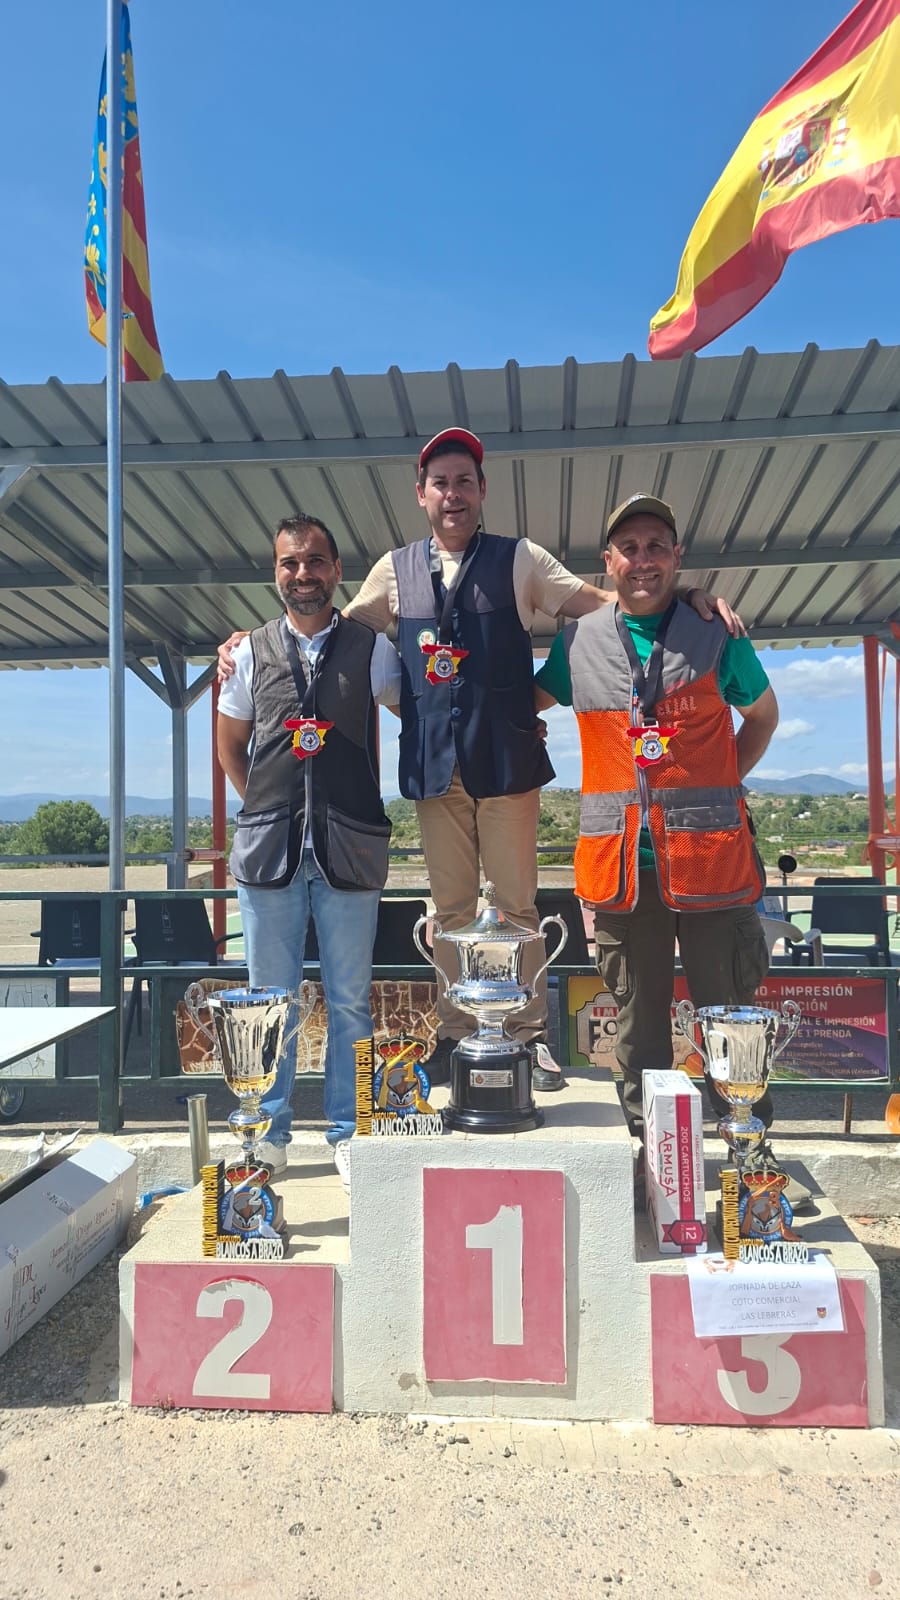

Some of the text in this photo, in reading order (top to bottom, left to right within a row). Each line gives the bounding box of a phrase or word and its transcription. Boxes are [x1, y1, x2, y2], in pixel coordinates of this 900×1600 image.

[781, 984, 853, 996] IMPRESIÓN
[824, 1016, 876, 1026] IMPRESIÓN
[814, 1029, 852, 1038] PRENDA
[352, 1038, 373, 1063] ESPAÑA
[356, 1063, 373, 1073] DE
[403, 1061, 417, 1082] 1
[356, 1074, 373, 1118] CAMPEONATO
[372, 1117, 443, 1136] BLANCOS A BRAZO
[659, 1130, 677, 1197] ARMUSA
[680, 1126, 691, 1202] 200 CARTUCHOS
[249, 1186, 262, 1205] 2
[202, 1198, 217, 1242] CAMPEONATO
[723, 1201, 739, 1243] CAMPEONATO
[685, 1226, 698, 1240] 12
[216, 1241, 284, 1258] BLANCOS A BRAZO
[740, 1244, 808, 1262] BLANCOS A BRAZO
[466, 1205, 523, 1345] 1
[729, 1281, 802, 1291] JORNADA DE CAZA
[732, 1296, 800, 1306] COTO COMERCIAL
[741, 1311, 796, 1320] LAS LEBRERAS
[192, 1278, 273, 1399] 2
[717, 1332, 801, 1416] 3
